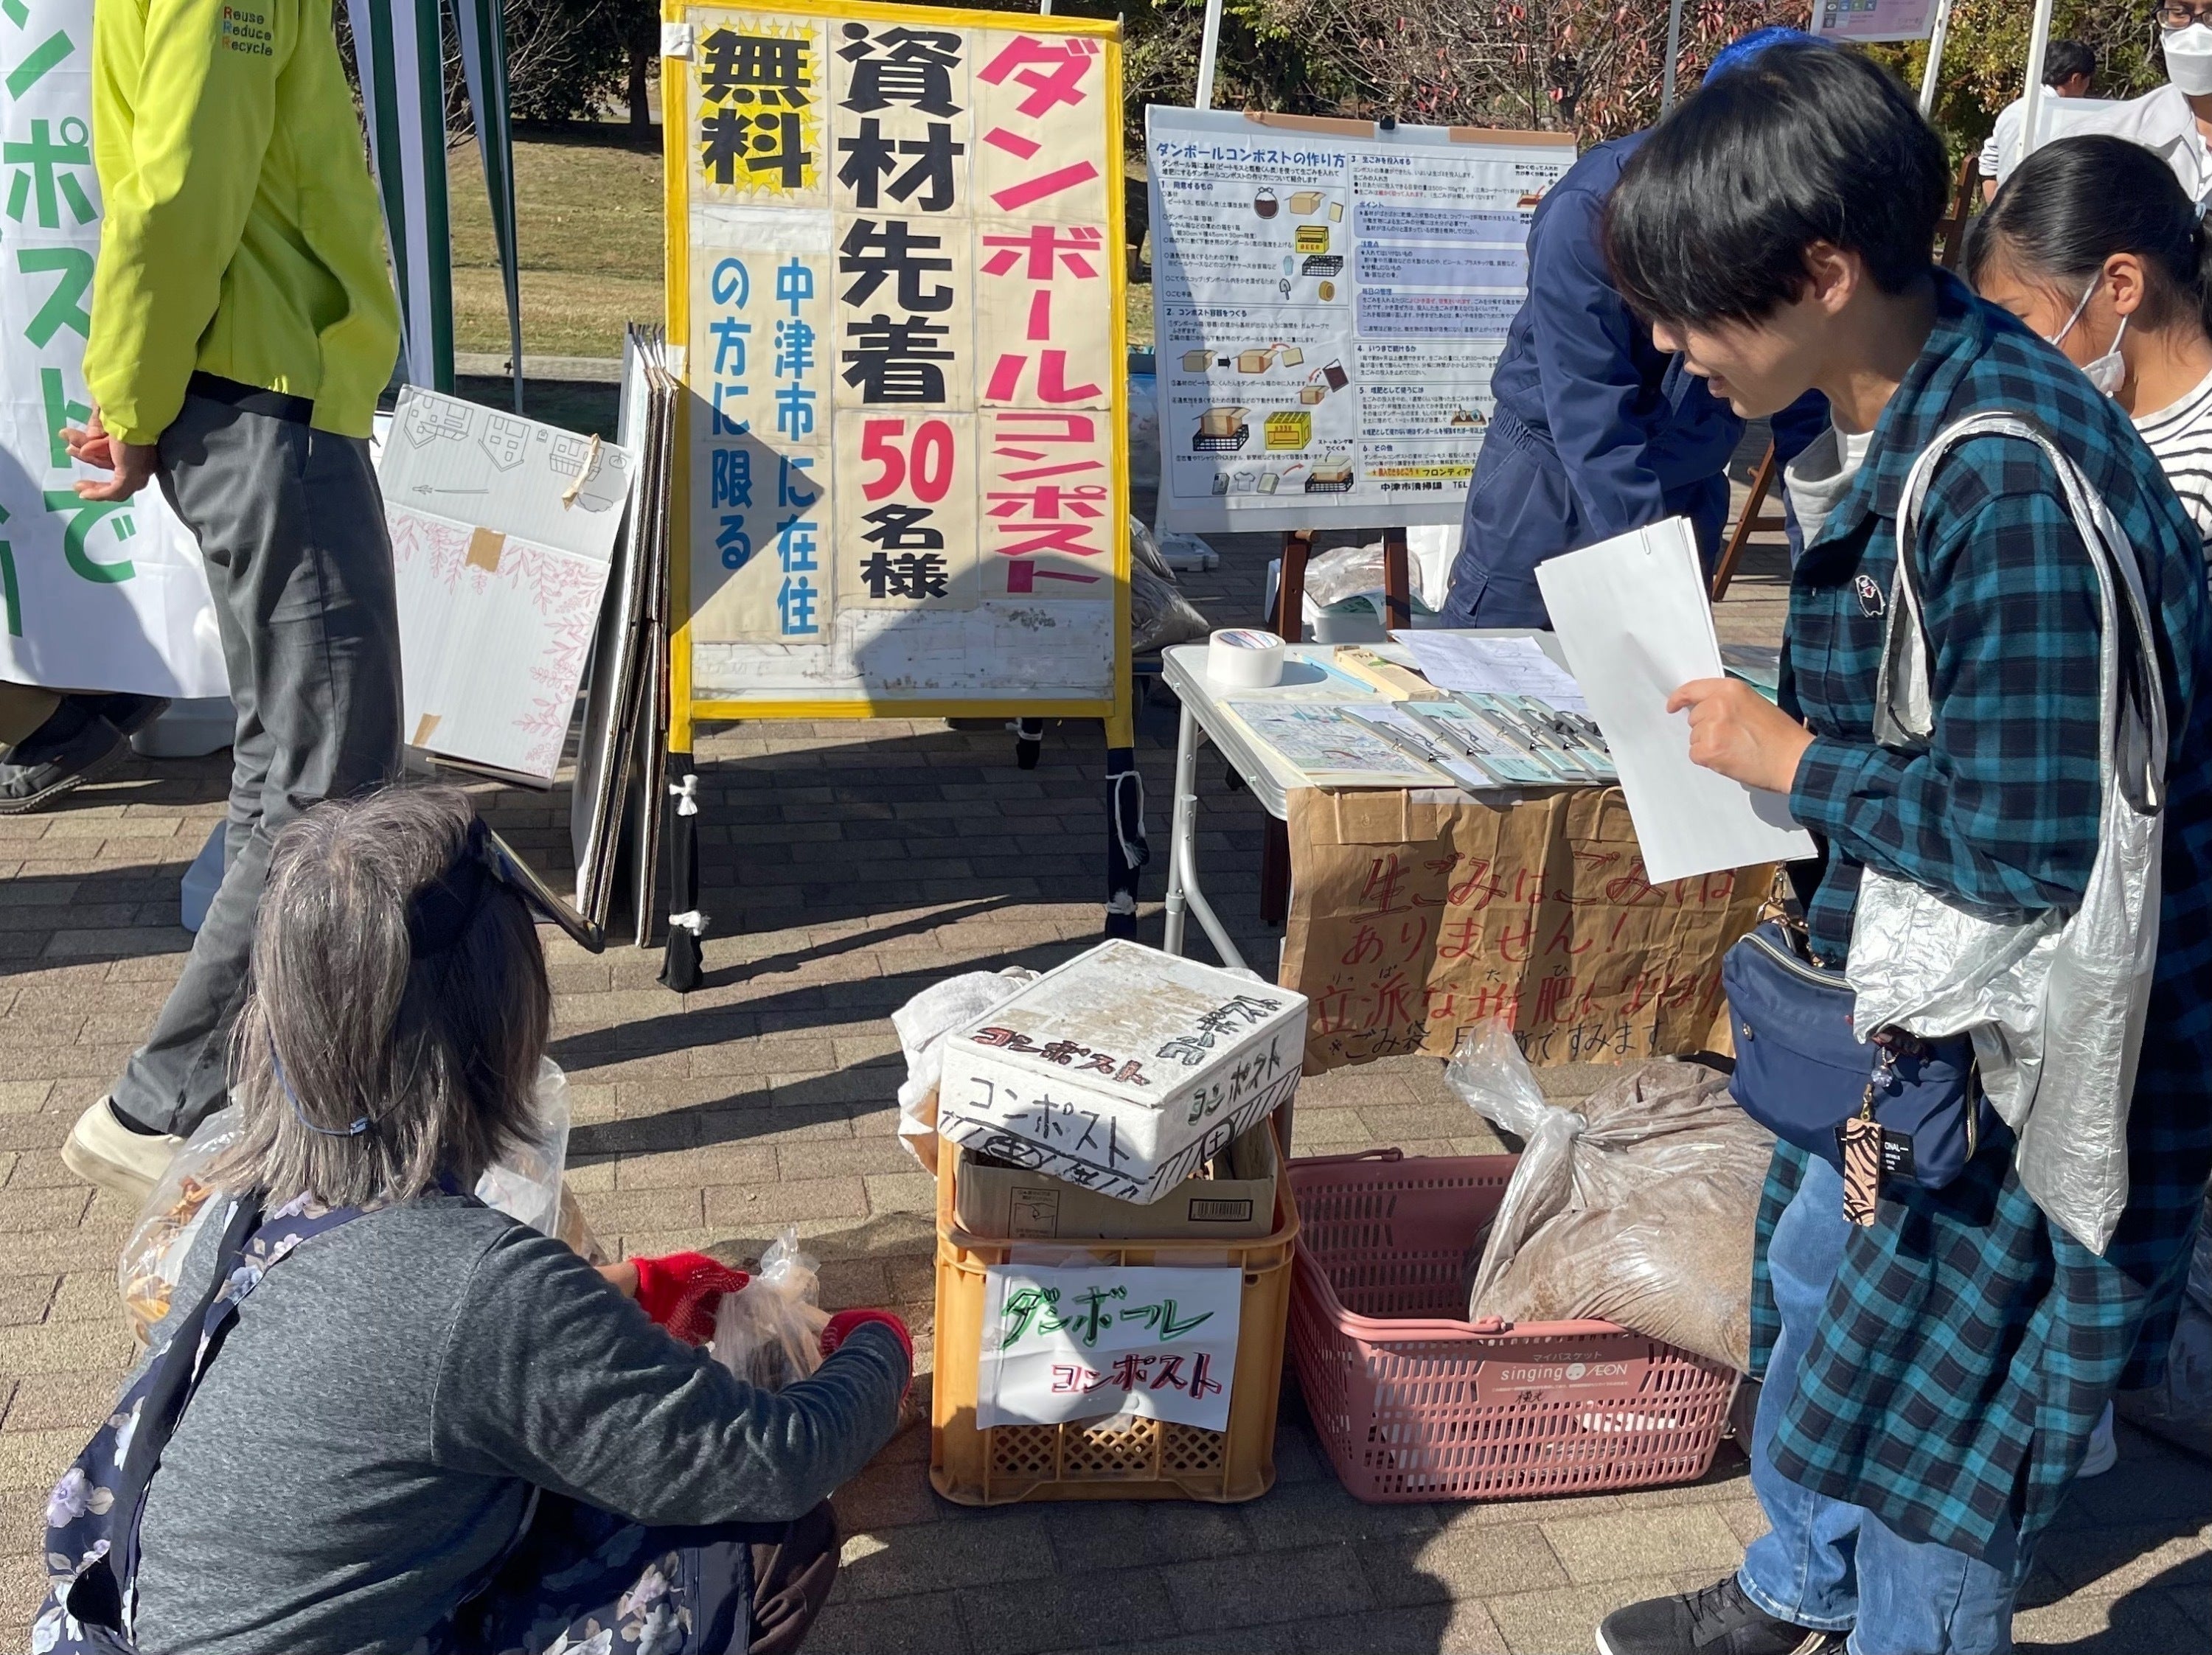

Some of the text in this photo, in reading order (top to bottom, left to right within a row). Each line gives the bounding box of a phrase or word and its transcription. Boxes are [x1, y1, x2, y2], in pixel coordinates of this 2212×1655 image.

[223, 6, 265, 24] Reuse
[223, 20, 271, 41] Reduce
[222, 36, 273, 56] Recycle
[701, 28, 812, 189] 無料
[1155, 142, 1346, 168] ダンボールコンポストの作り方
[977, 35, 1107, 593] ダンボールコンポスト
[709, 257, 753, 570] の方に限る
[774, 257, 819, 635] 中津市に在住
[1453, 481, 1468, 489] TEL
[970, 1076, 1130, 1168] コンポスト
[1001, 1285, 1214, 1351] ダンボール
[1500, 1365, 1563, 1382] singing
[1533, 1351, 1602, 1362] マイバスケット
[1051, 1352, 1222, 1400] コンポスト
